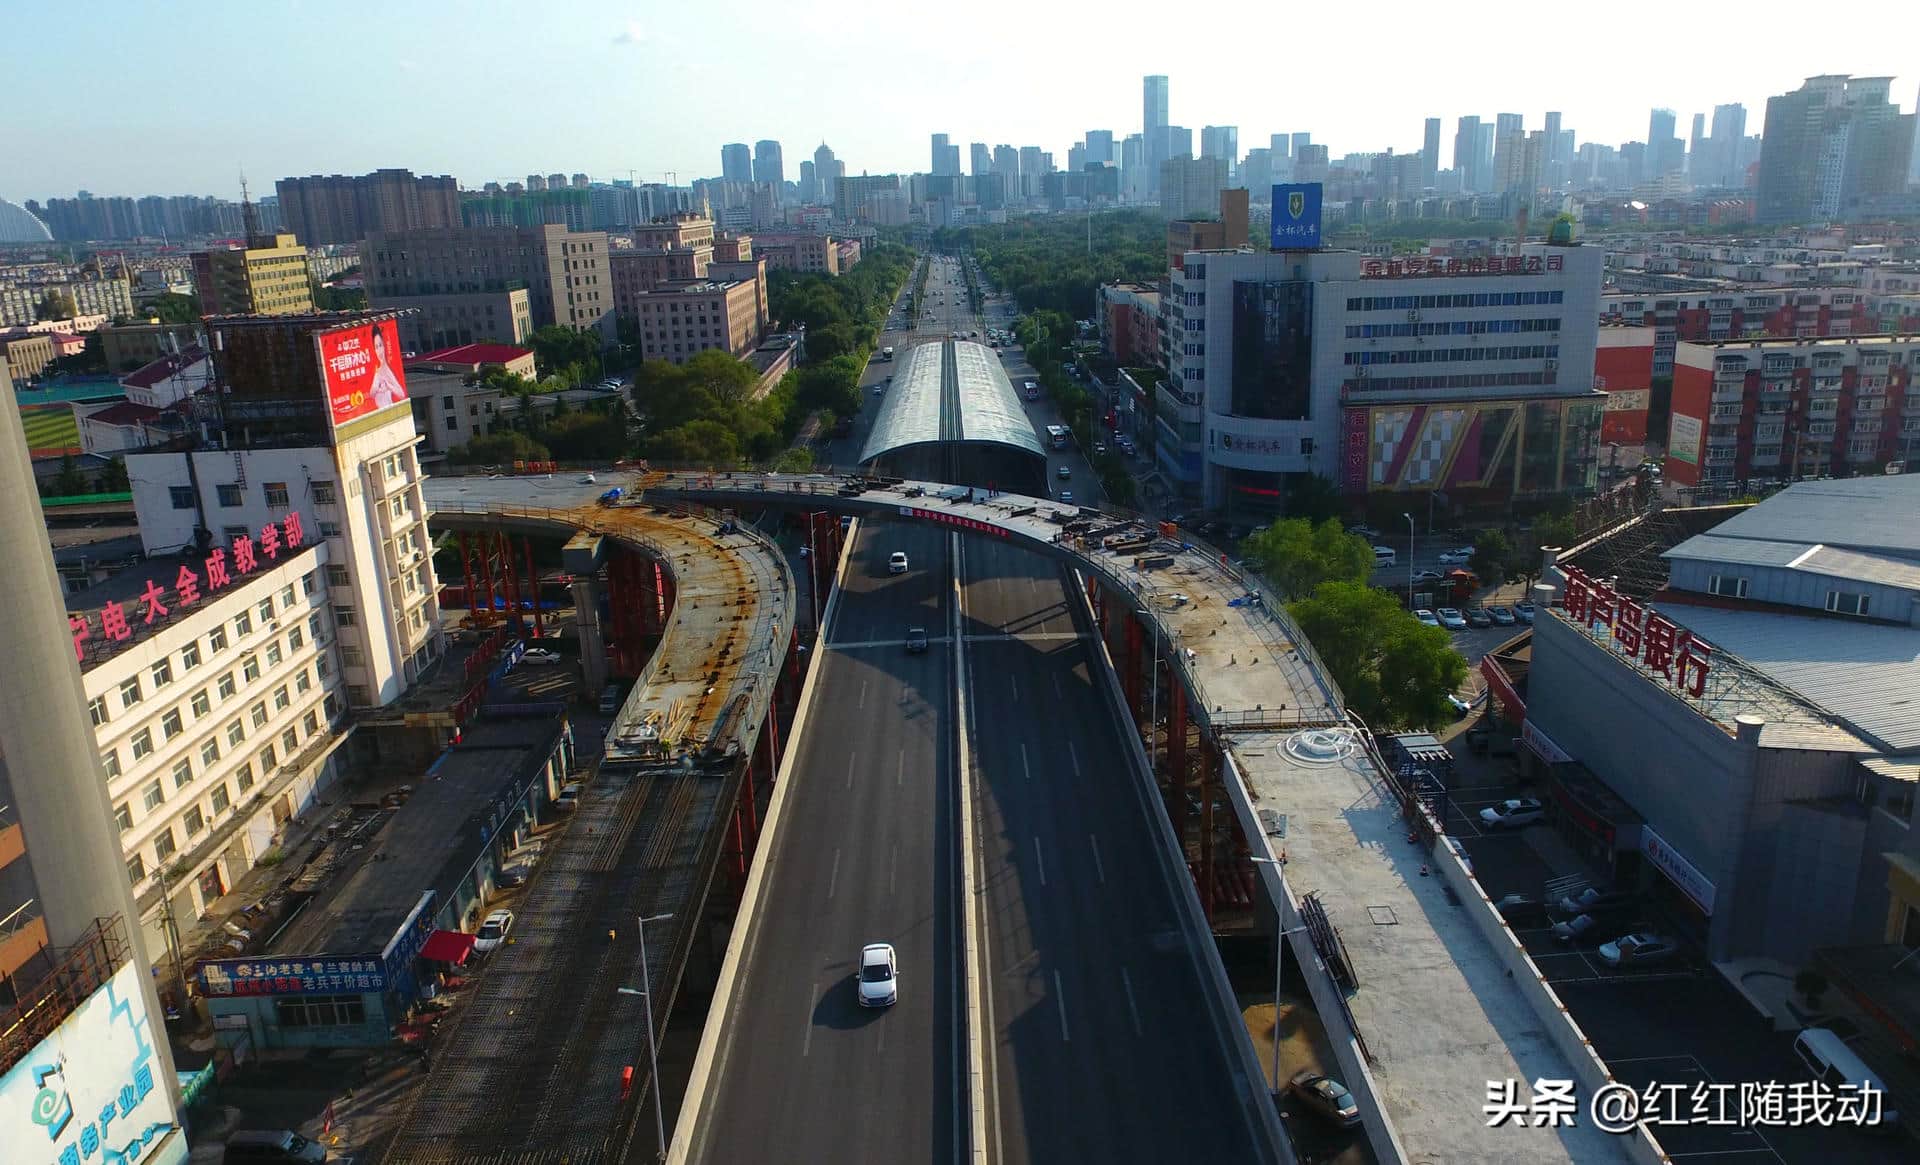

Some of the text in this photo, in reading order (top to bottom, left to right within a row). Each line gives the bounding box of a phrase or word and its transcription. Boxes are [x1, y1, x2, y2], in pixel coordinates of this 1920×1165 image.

[1564, 564, 1711, 698] 葫芦岛银行
[303, 974, 383, 991] 老兵平价超市
